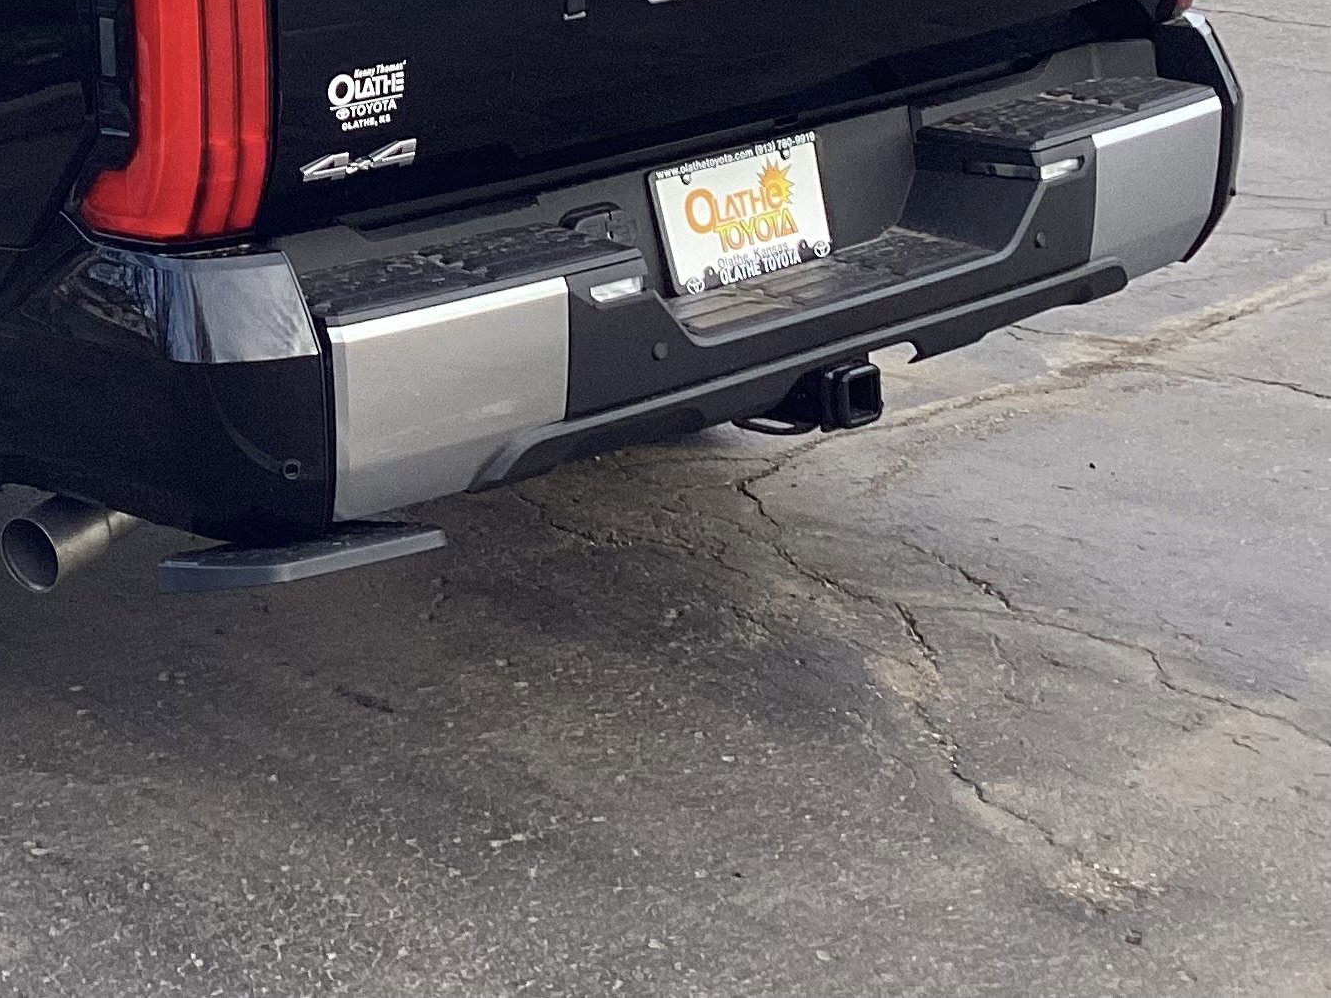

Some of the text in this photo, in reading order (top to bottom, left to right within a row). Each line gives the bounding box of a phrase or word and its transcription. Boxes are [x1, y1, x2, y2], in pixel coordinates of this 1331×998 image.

[328, 72, 405, 107] OLATHE
[350, 98, 397, 118] TOYOTA
[656, 148, 754, 179] www.olathetoyota.com
[713, 208, 799, 253] TOYOTA
[719, 248, 802, 285] OLATHE TOYOTA
